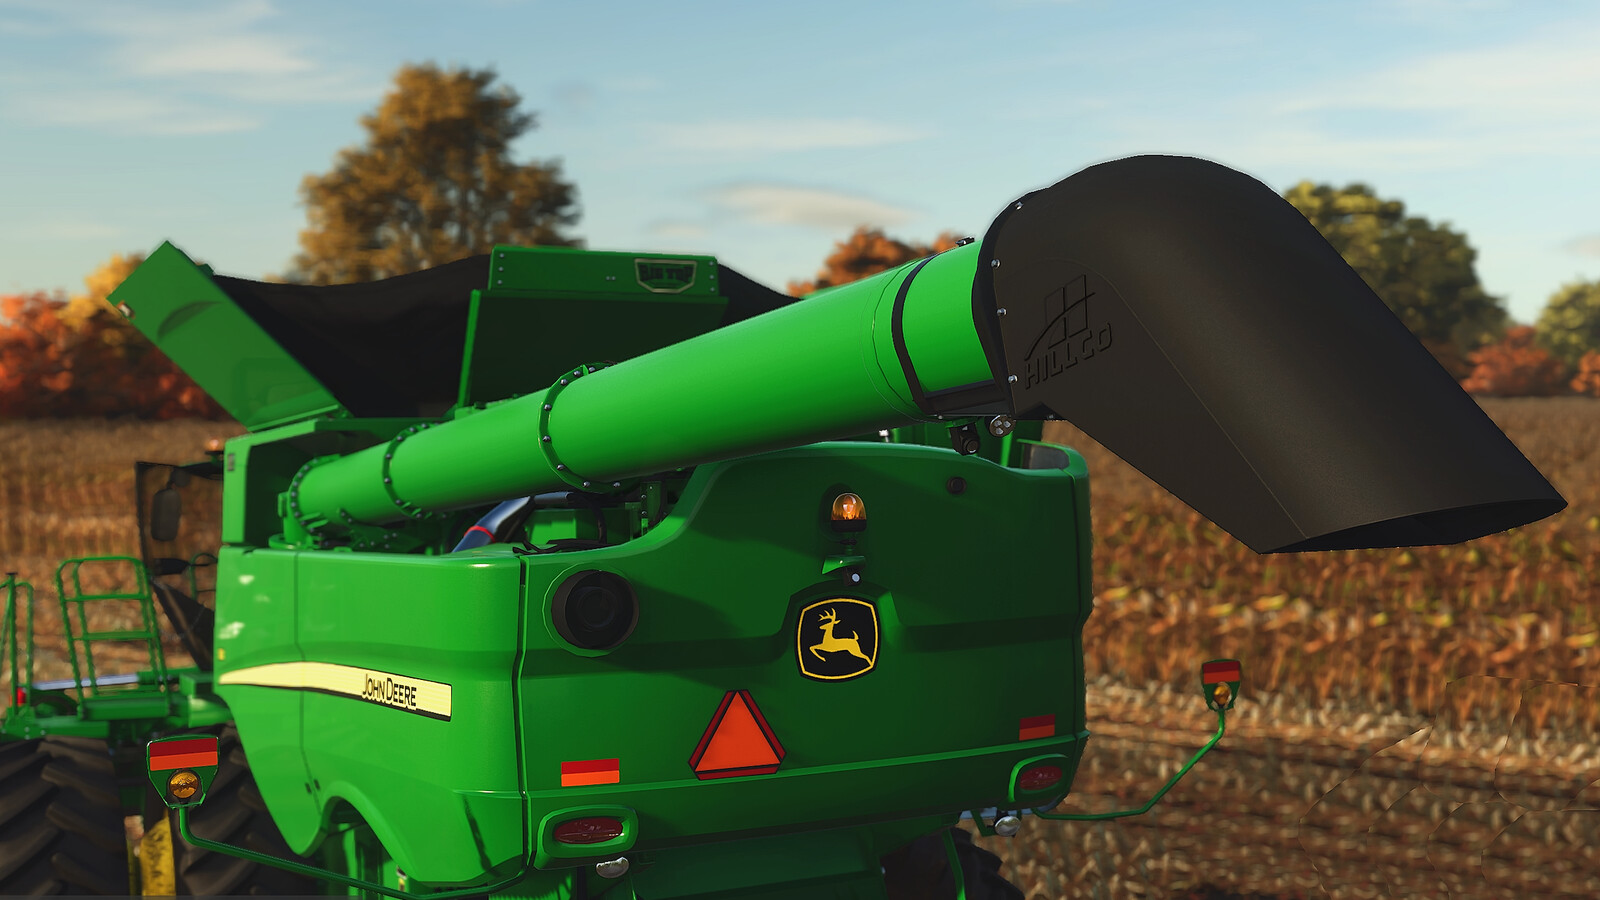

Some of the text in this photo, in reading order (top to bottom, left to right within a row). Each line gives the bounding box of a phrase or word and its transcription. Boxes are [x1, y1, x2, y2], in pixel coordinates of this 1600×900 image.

[1024, 321, 1112, 390] HILLCO
[362, 673, 417, 706] JOHN DEERE
